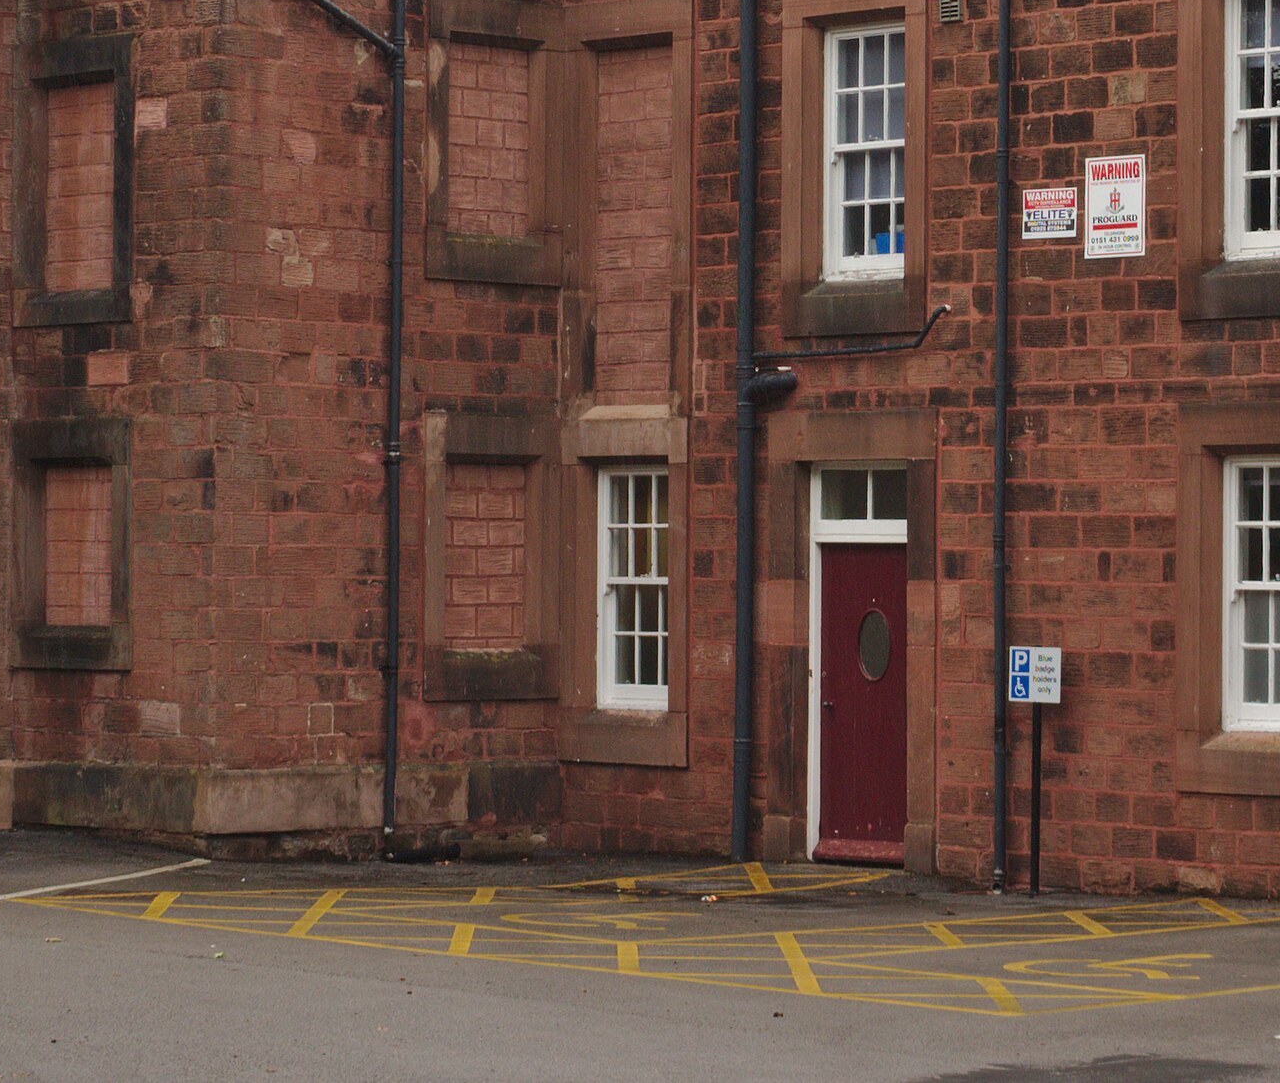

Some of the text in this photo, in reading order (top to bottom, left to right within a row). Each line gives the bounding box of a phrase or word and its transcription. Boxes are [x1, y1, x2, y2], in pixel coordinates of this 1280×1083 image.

[1091, 161, 1140, 181] WARNING
[1026, 190, 1074, 201] WARNING
[1033, 209, 1066, 219] ELITE
[1092, 214, 1138, 224] PROGUARD
[1091, 236, 1107, 244] 0151
[1108, 235, 1121, 243] 431
[1014, 651, 1028, 671] P
[1038, 654, 1053, 662] Blue
[1035, 665, 1055, 674] badge
[1033, 675, 1057, 683] holders
[1037, 685, 1051, 694] only
